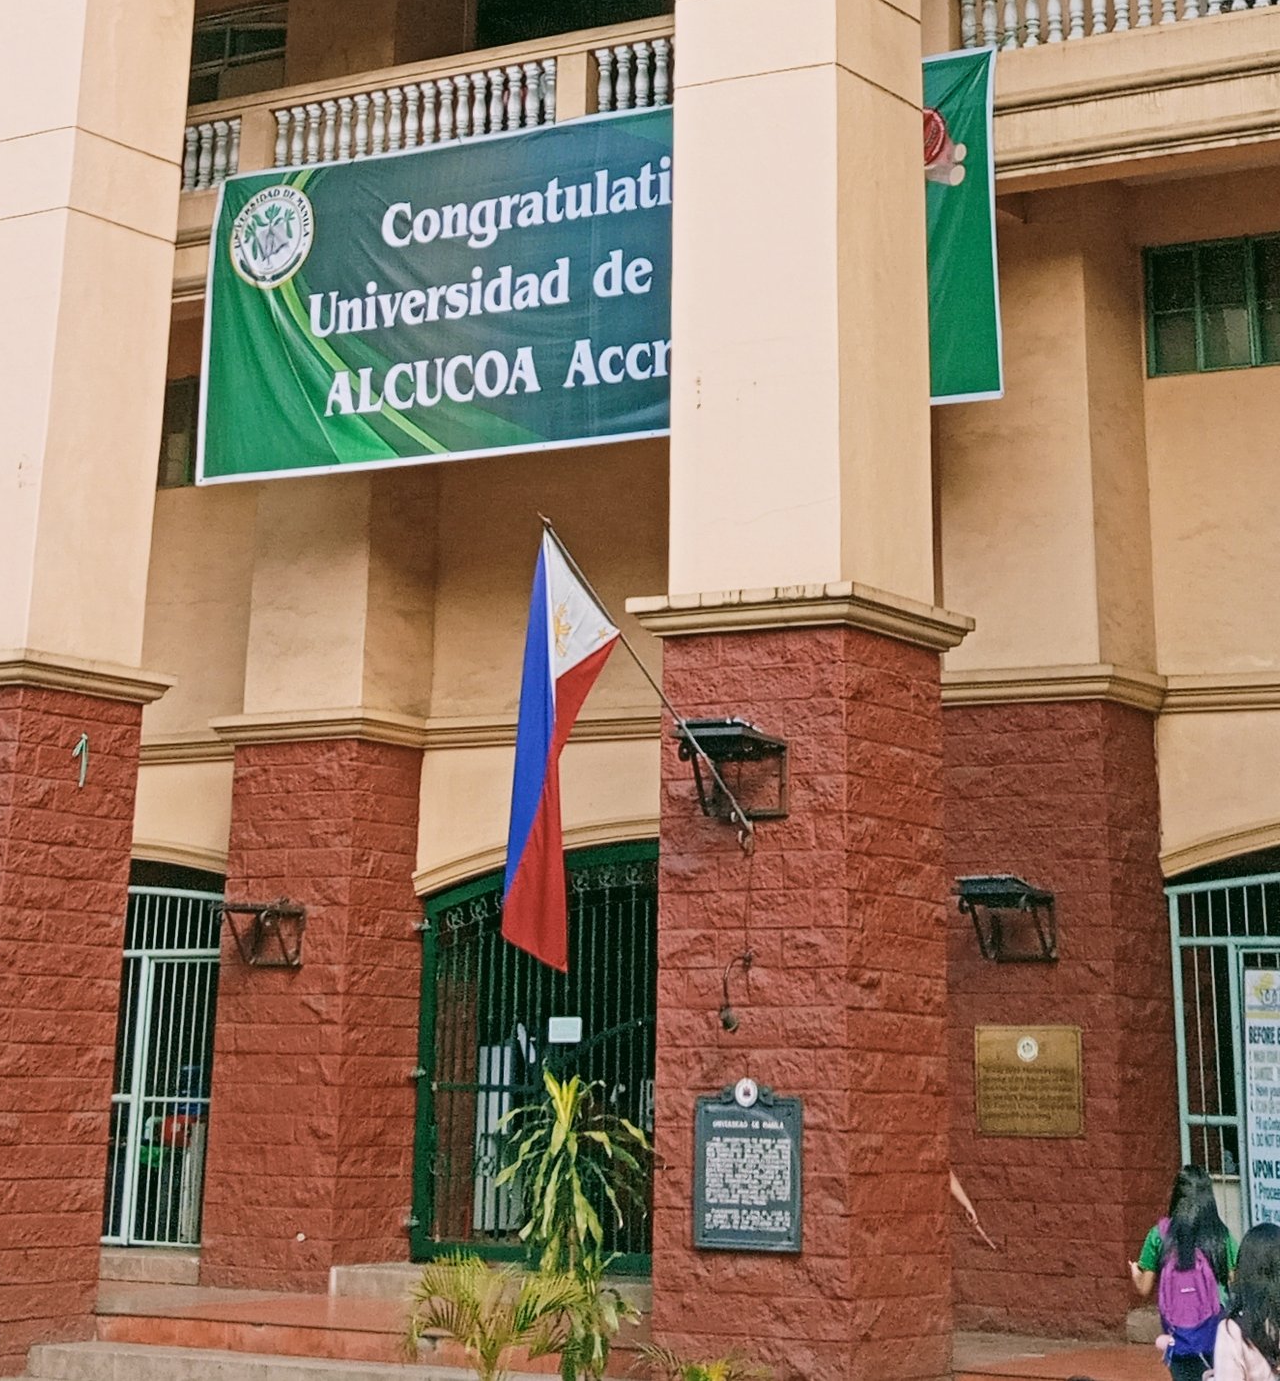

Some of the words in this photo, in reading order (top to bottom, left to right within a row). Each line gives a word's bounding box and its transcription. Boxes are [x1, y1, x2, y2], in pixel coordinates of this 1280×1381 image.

[234, 188, 281, 249] UNIVERSIDAD
[381, 155, 673, 249] Congratulati
[308, 256, 571, 339] Universidad
[592, 249, 654, 299] de
[324, 346, 542, 418] ALCUCOA
[1249, 1025, 1276, 1045] BEFORE
[1252, 1158, 1273, 1179] UPON
